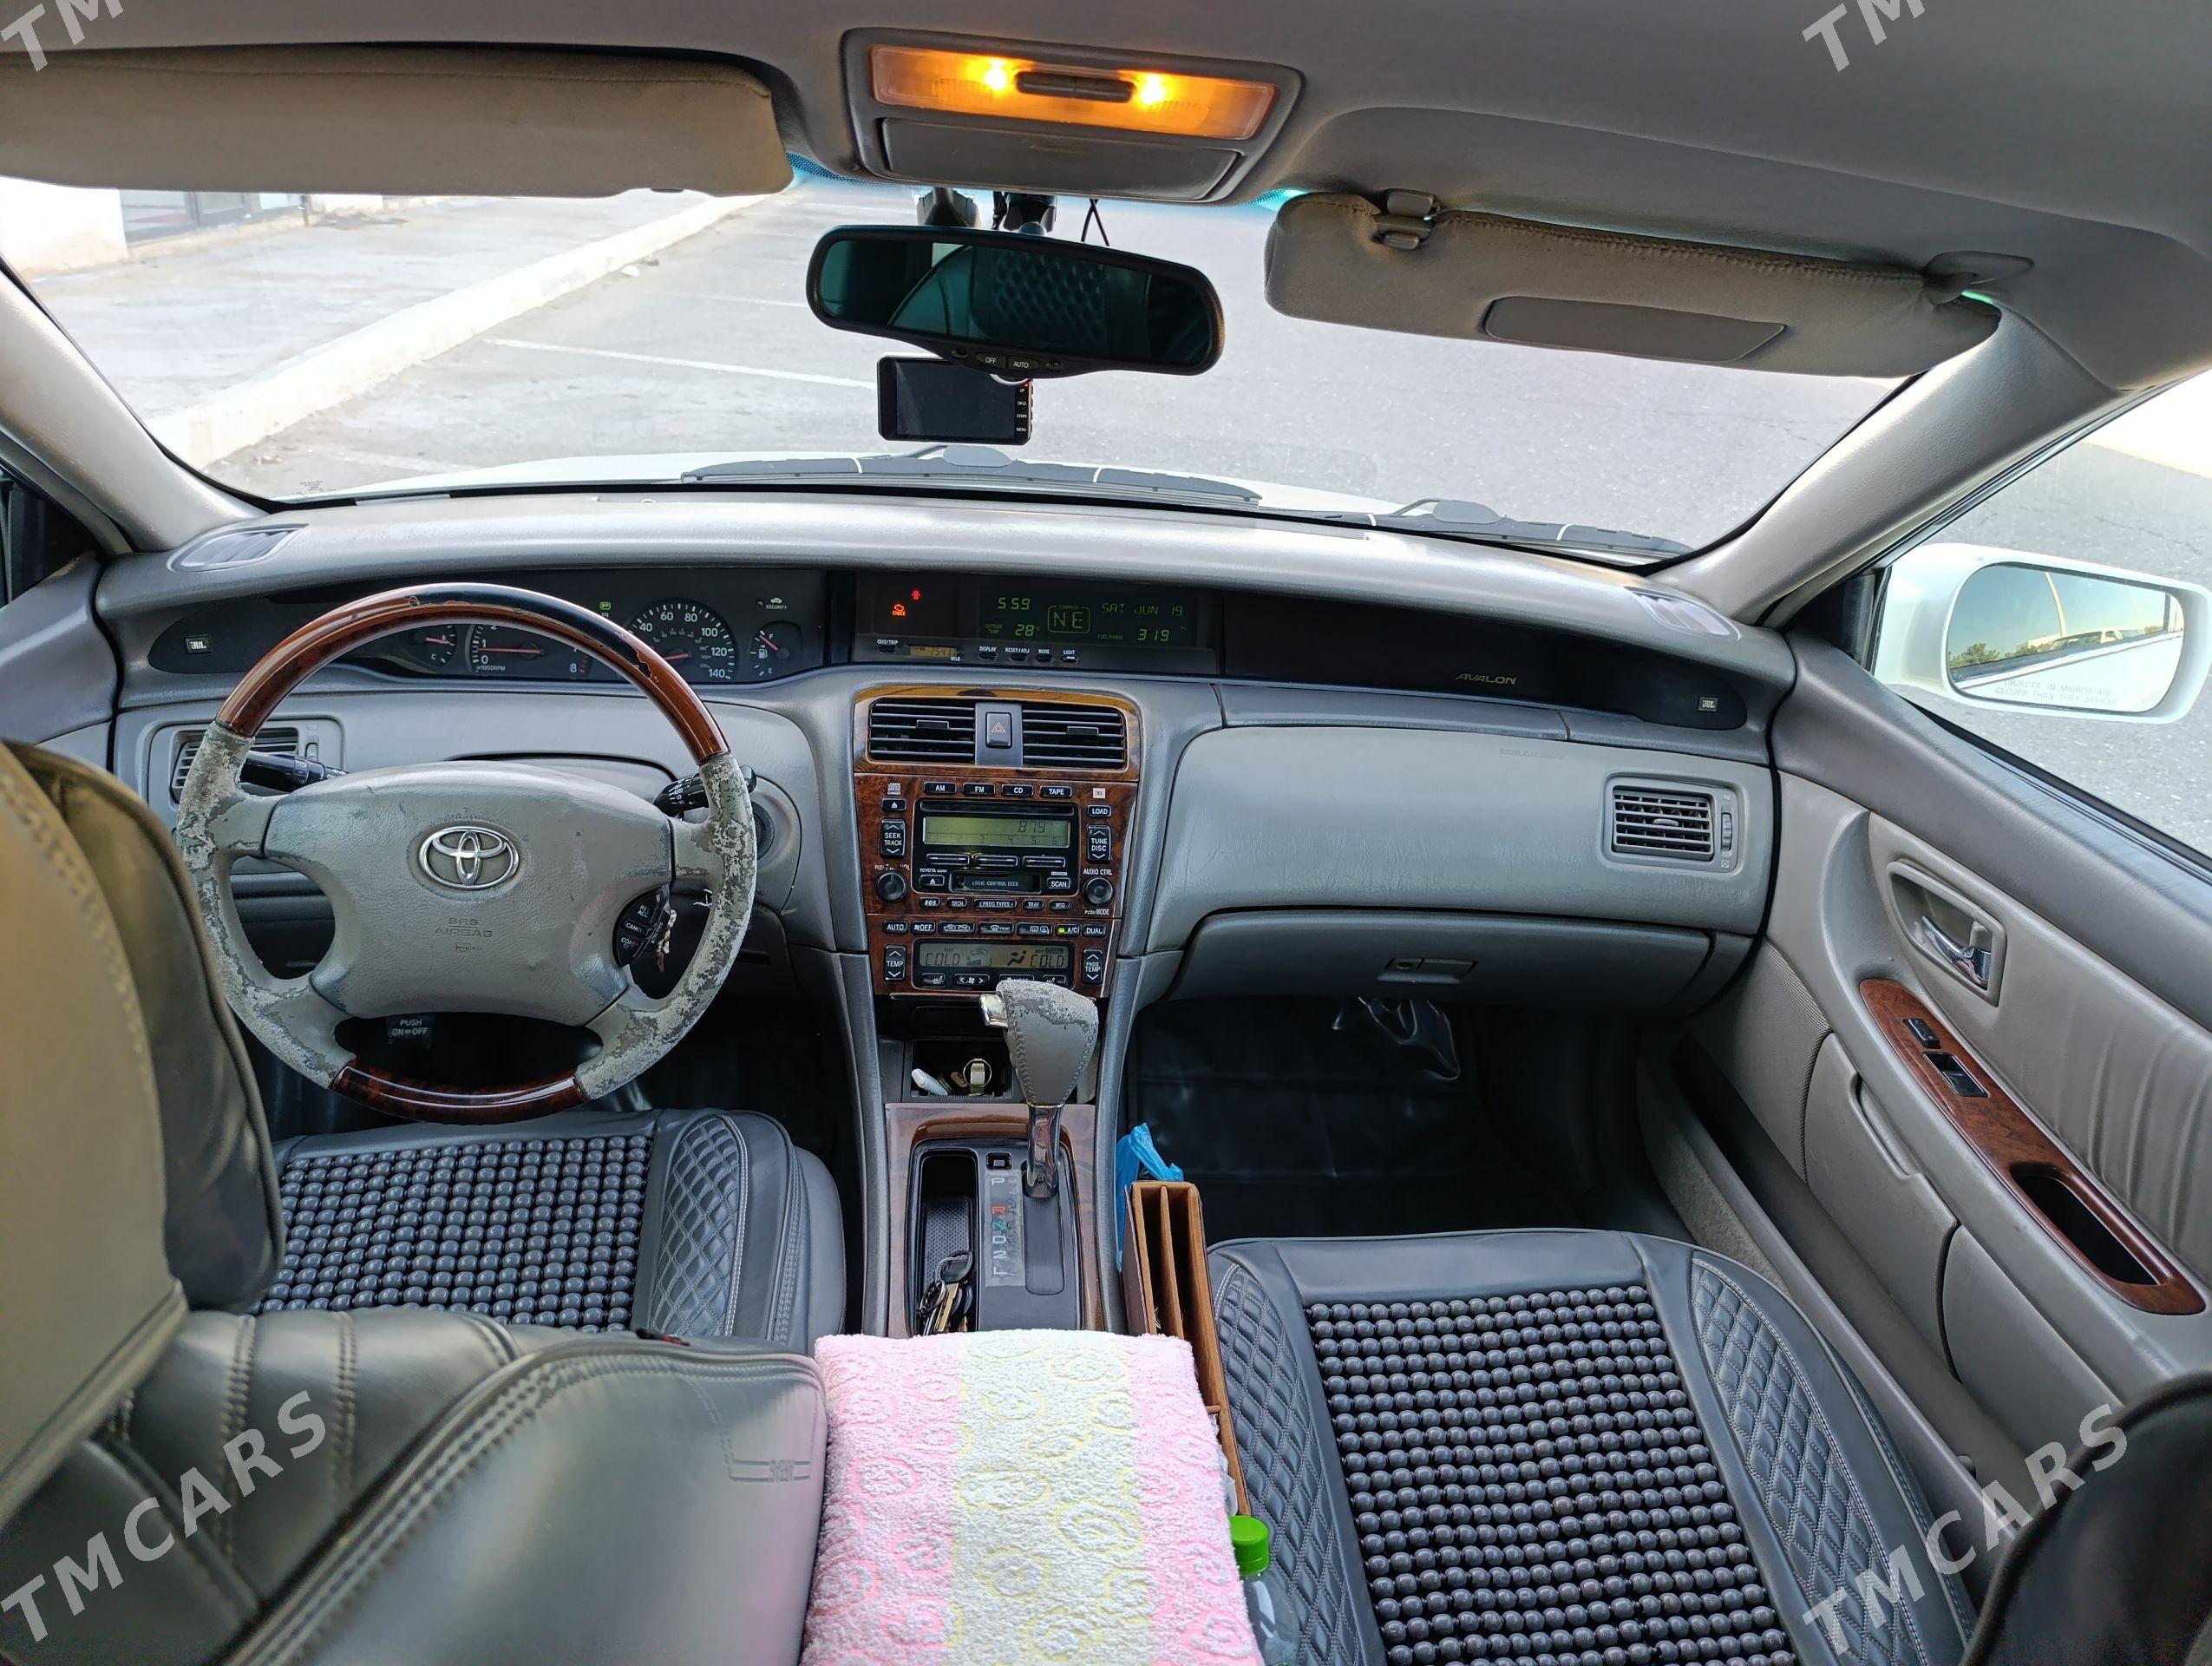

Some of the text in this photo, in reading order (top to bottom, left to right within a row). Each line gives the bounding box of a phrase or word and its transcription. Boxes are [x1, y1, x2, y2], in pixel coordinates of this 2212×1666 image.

[1102, 603, 1125, 613] SAT
[1134, 606, 1159, 615] JUN
[661, 612, 674, 621] 60
[684, 613, 697, 623] 80
[639, 622, 652, 632] 40
[701, 627, 718, 637] 100
[1137, 629, 1170, 641] 319
[481, 640, 487, 648] 1
[711, 647, 728, 657] 120
[481, 655, 488, 665] 0
[570, 663, 578, 673] 8
[708, 669, 725, 679] 140
[1456, 672, 1516, 685] AVALON
[2004, 679, 2041, 688] OBJECTS
[2061, 685, 2093, 694] MIRROR
[1995, 686, 2027, 696] CLOSER
[2033, 691, 2054, 699] THAN
[448, 917, 479, 927] SRS
[434, 928, 494, 938] AIRBAG
[926, 953, 960, 967] COLD
[1031, 954, 1064, 967] COLD
[391, 1027, 429, 1037] ON OFF
[991, 1177, 1005, 1186] P
[991, 1205, 1006, 1214] R
[991, 1220, 1008, 1230] N
[991, 1235, 1007, 1243] D
[993, 1250, 1007, 1259] 2
